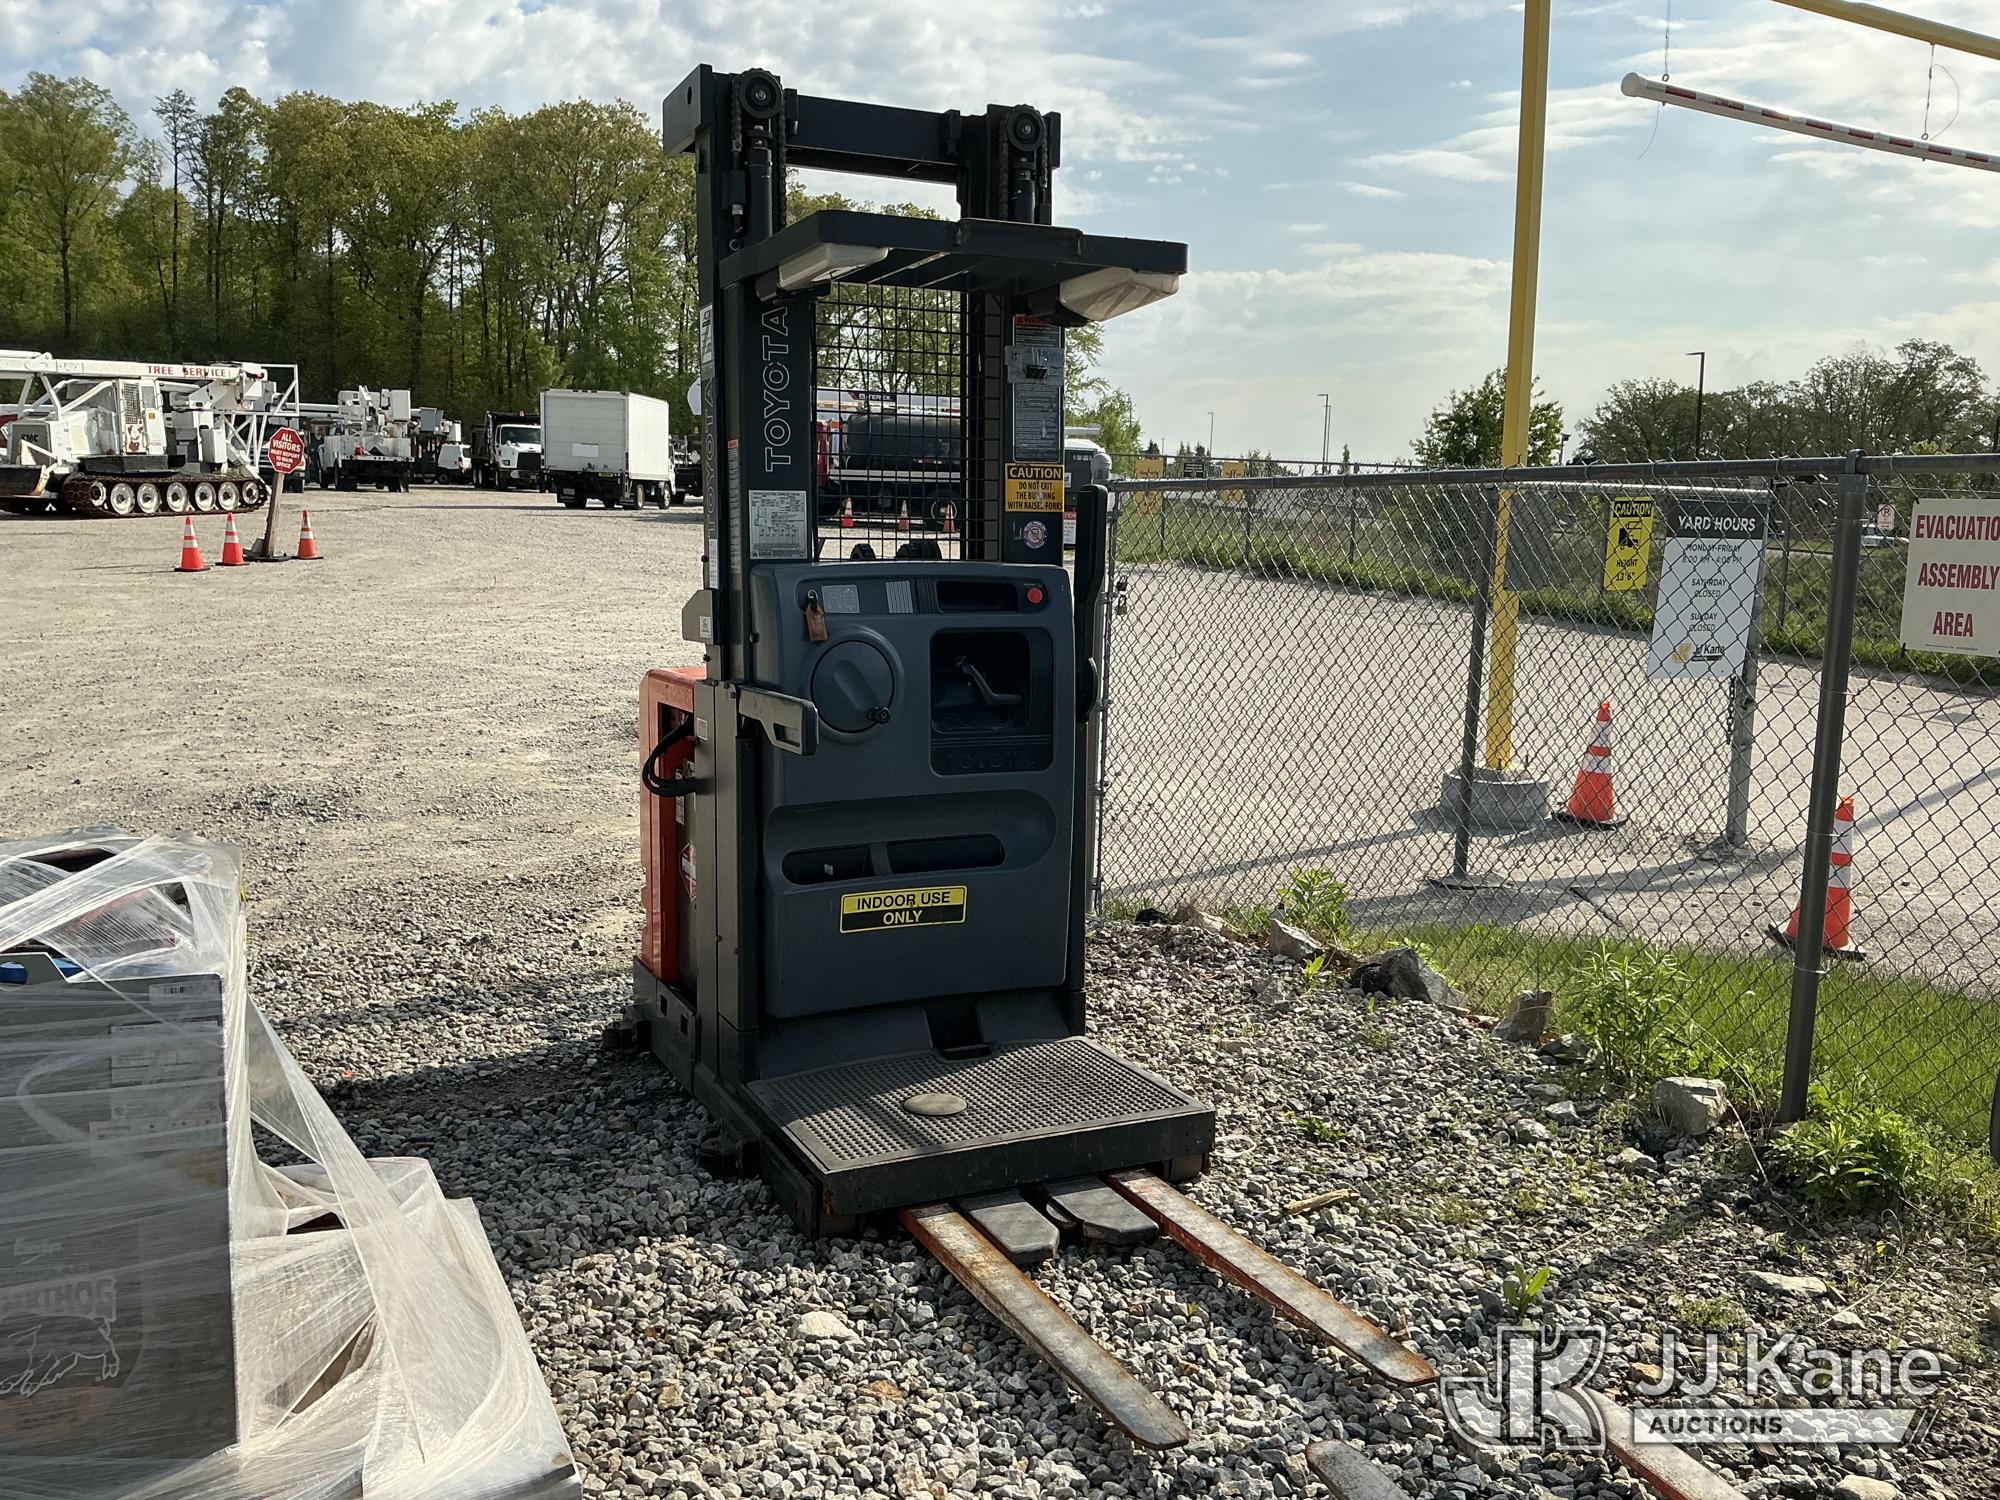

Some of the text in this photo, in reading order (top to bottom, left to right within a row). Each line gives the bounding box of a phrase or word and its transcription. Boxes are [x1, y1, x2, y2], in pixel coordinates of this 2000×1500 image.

[146, 365, 227, 377] TREE SERVICE
[761, 306, 792, 473] TOYOTA
[281, 433, 292, 442] ALL
[273, 439, 300, 452] VISITORS
[705, 376, 716, 538] TOYOTA
[1009, 467, 1061, 479] CAUTION
[1018, 481, 1053, 491] DO NOT EXIT
[1015, 491, 1028, 500] THE
[1007, 501, 1023, 510] WITH
[1045, 502, 1063, 510] FORKS
[1615, 502, 1652, 516] CAUTION
[1678, 515, 1756, 532] YARD HOURS
[1915, 514, 2000, 542] EVACUATIO
[1917, 562, 2000, 590] ASSEMBLY
[1932, 611, 1974, 637] AREA
[856, 891, 951, 911] INDOOR USE
[882, 909, 923, 925] ONLY
